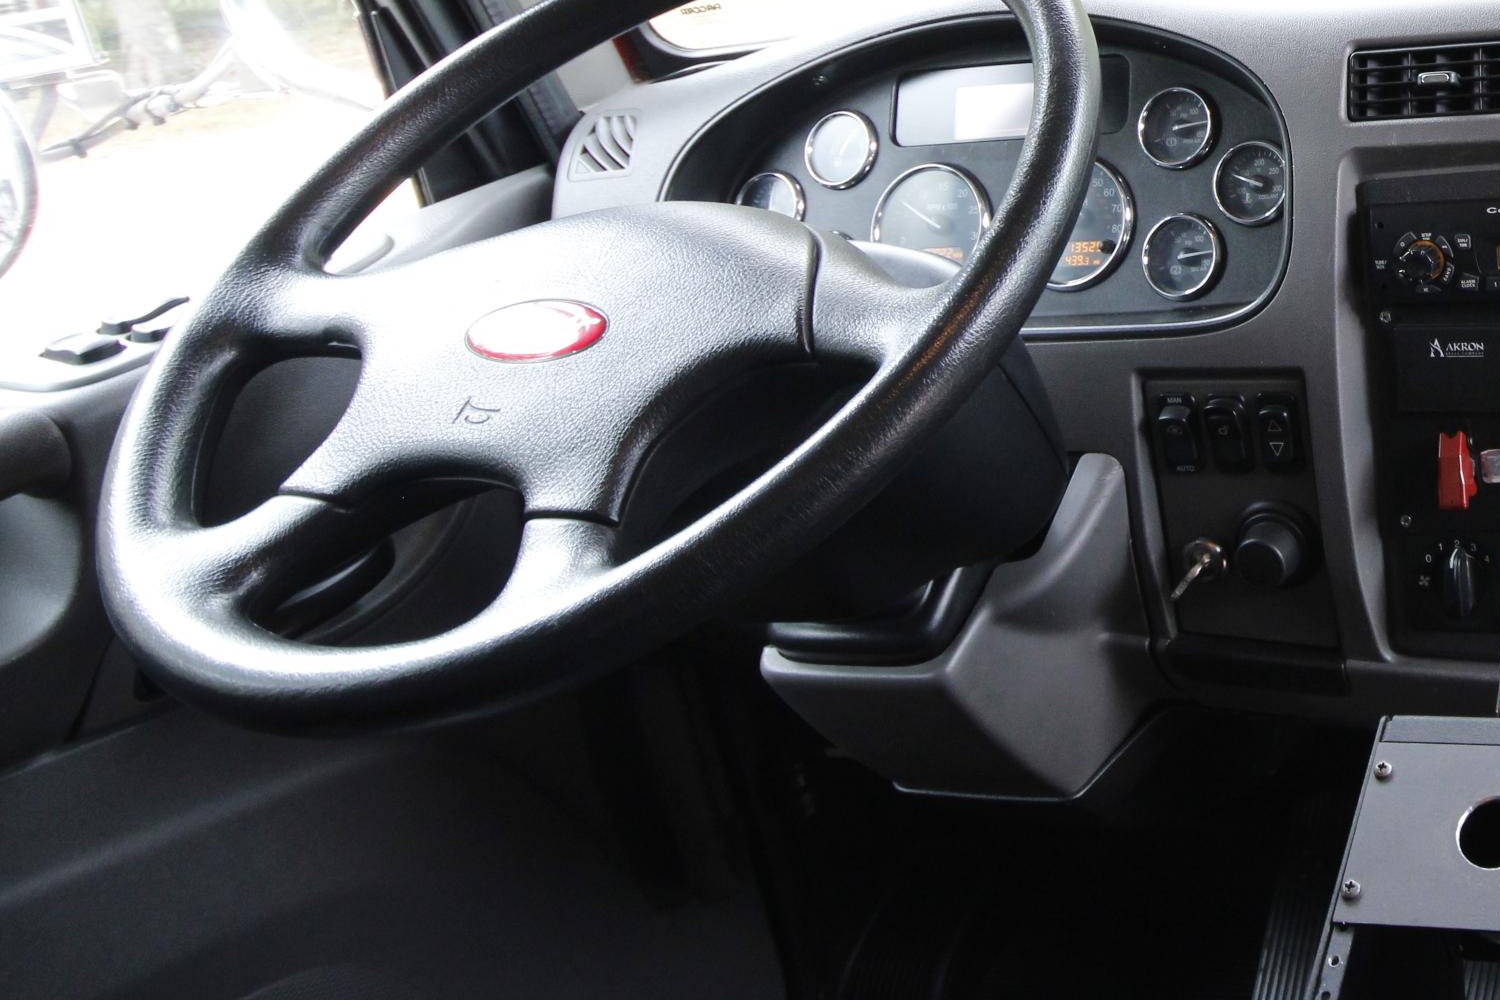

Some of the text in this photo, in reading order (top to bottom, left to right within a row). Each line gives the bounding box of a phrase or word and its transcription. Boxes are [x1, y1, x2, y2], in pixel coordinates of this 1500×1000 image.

[1103, 188, 1115, 197] 60
[1445, 341, 1485, 351] AKRON
[1437, 543, 1443, 551] 1
[1453, 539, 1460, 549] 2
[1470, 543, 1477, 552] 3
[1425, 553, 1432, 563] 0
